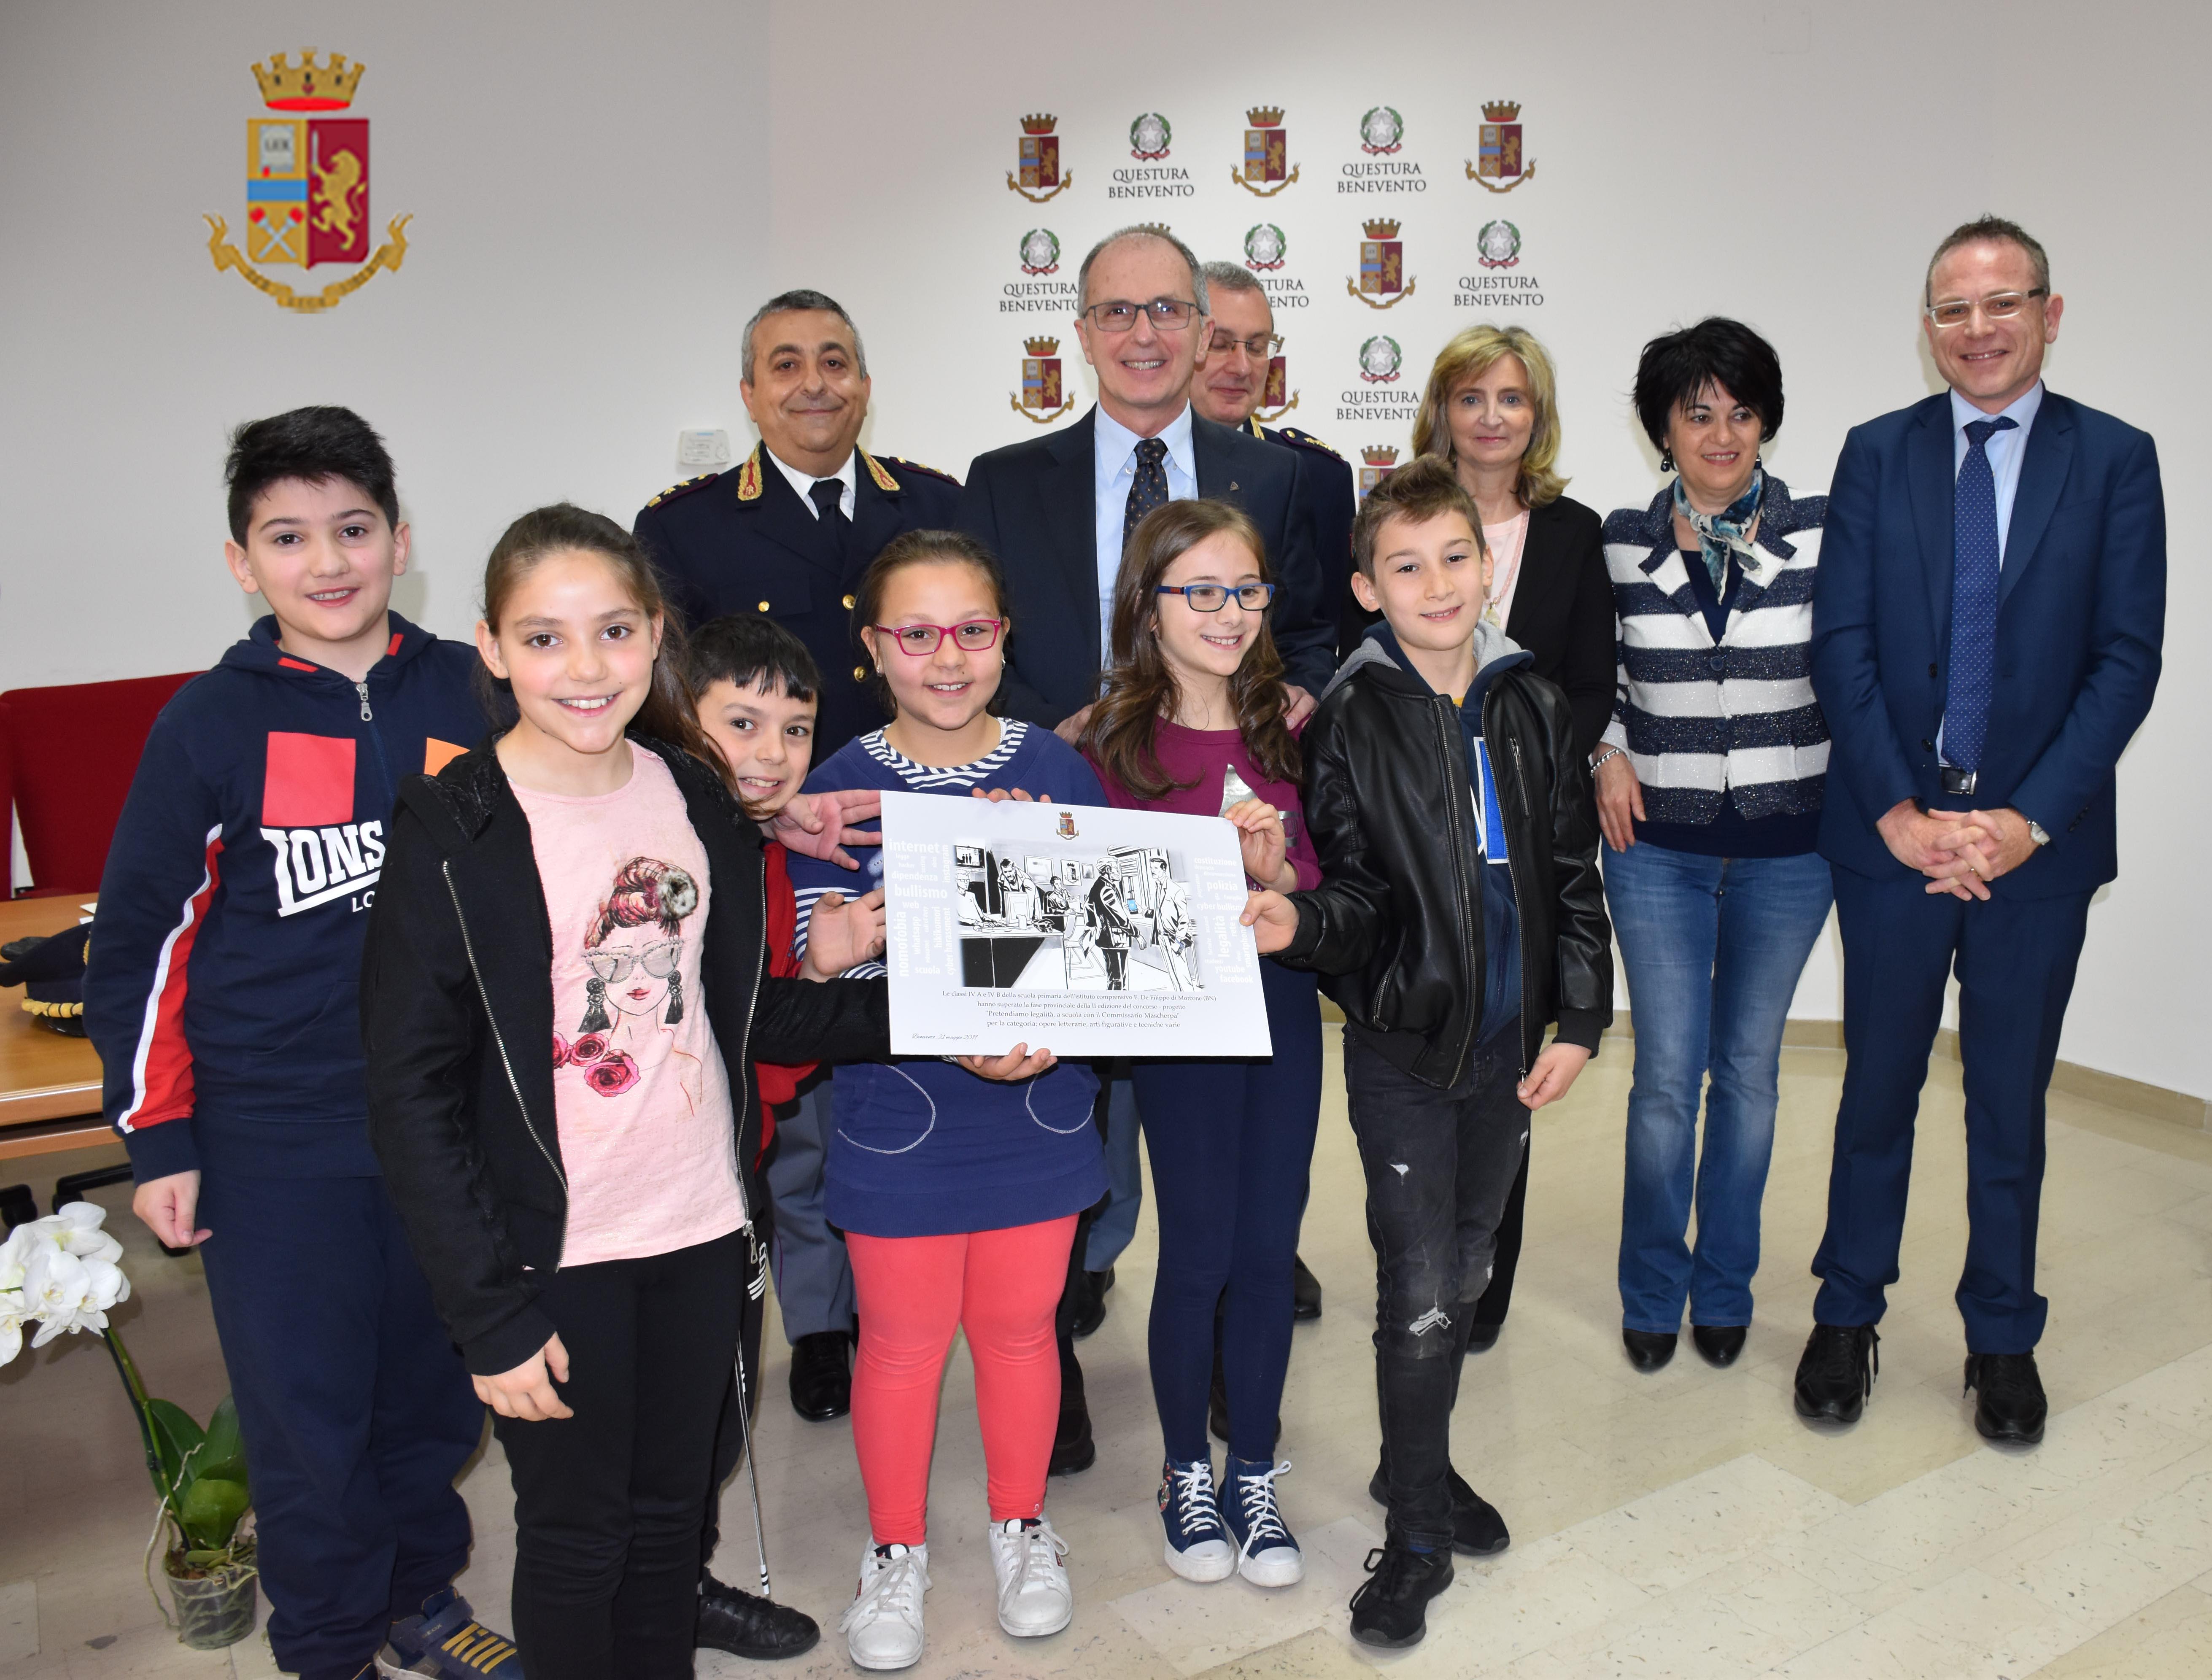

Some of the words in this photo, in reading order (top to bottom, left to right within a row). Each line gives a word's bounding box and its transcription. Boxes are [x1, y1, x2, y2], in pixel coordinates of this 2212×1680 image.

[1113, 168, 1189, 183] QUESTURA
[1342, 162, 1422, 178] QUESTURA
[1108, 184, 1194, 198] BENEVENTO
[1337, 180, 1426, 193] BENEVENTO
[1003, 283, 1078, 297] QUESTURA
[1264, 279, 1304, 291] TURA
[1459, 276, 1539, 291] QUESTURA
[1454, 294, 1543, 306] BENEVENTO
[1341, 391, 1419, 405] QUESTURA
[888, 838, 940, 853] internet
[260, 820, 386, 917] LONS
[942, 844, 952, 883] instagram
[1194, 857, 1238, 866] costituzione
[891, 871, 938, 881] dipendenza
[894, 884, 948, 898] bullismo
[1206, 880, 1238, 892] polizia
[352, 891, 375, 912] LO
[902, 901, 919, 909] web
[1197, 902, 1215, 911] cyber
[931, 906, 942, 948] hikikomori
[943, 908, 953, 952] harassment
[1229, 922, 1237, 937] rete
[912, 916, 922, 955] whatsapp
[1213, 916, 1231, 957] legalità
[893, 911, 909, 977] nomofobia
[914, 965, 940, 974] scuola
[945, 953, 956, 975] cyber
[1215, 965, 1246, 974] youtube
[1220, 974, 1254, 982] facebook
[1030, 1011, 1055, 1019] legalità,
